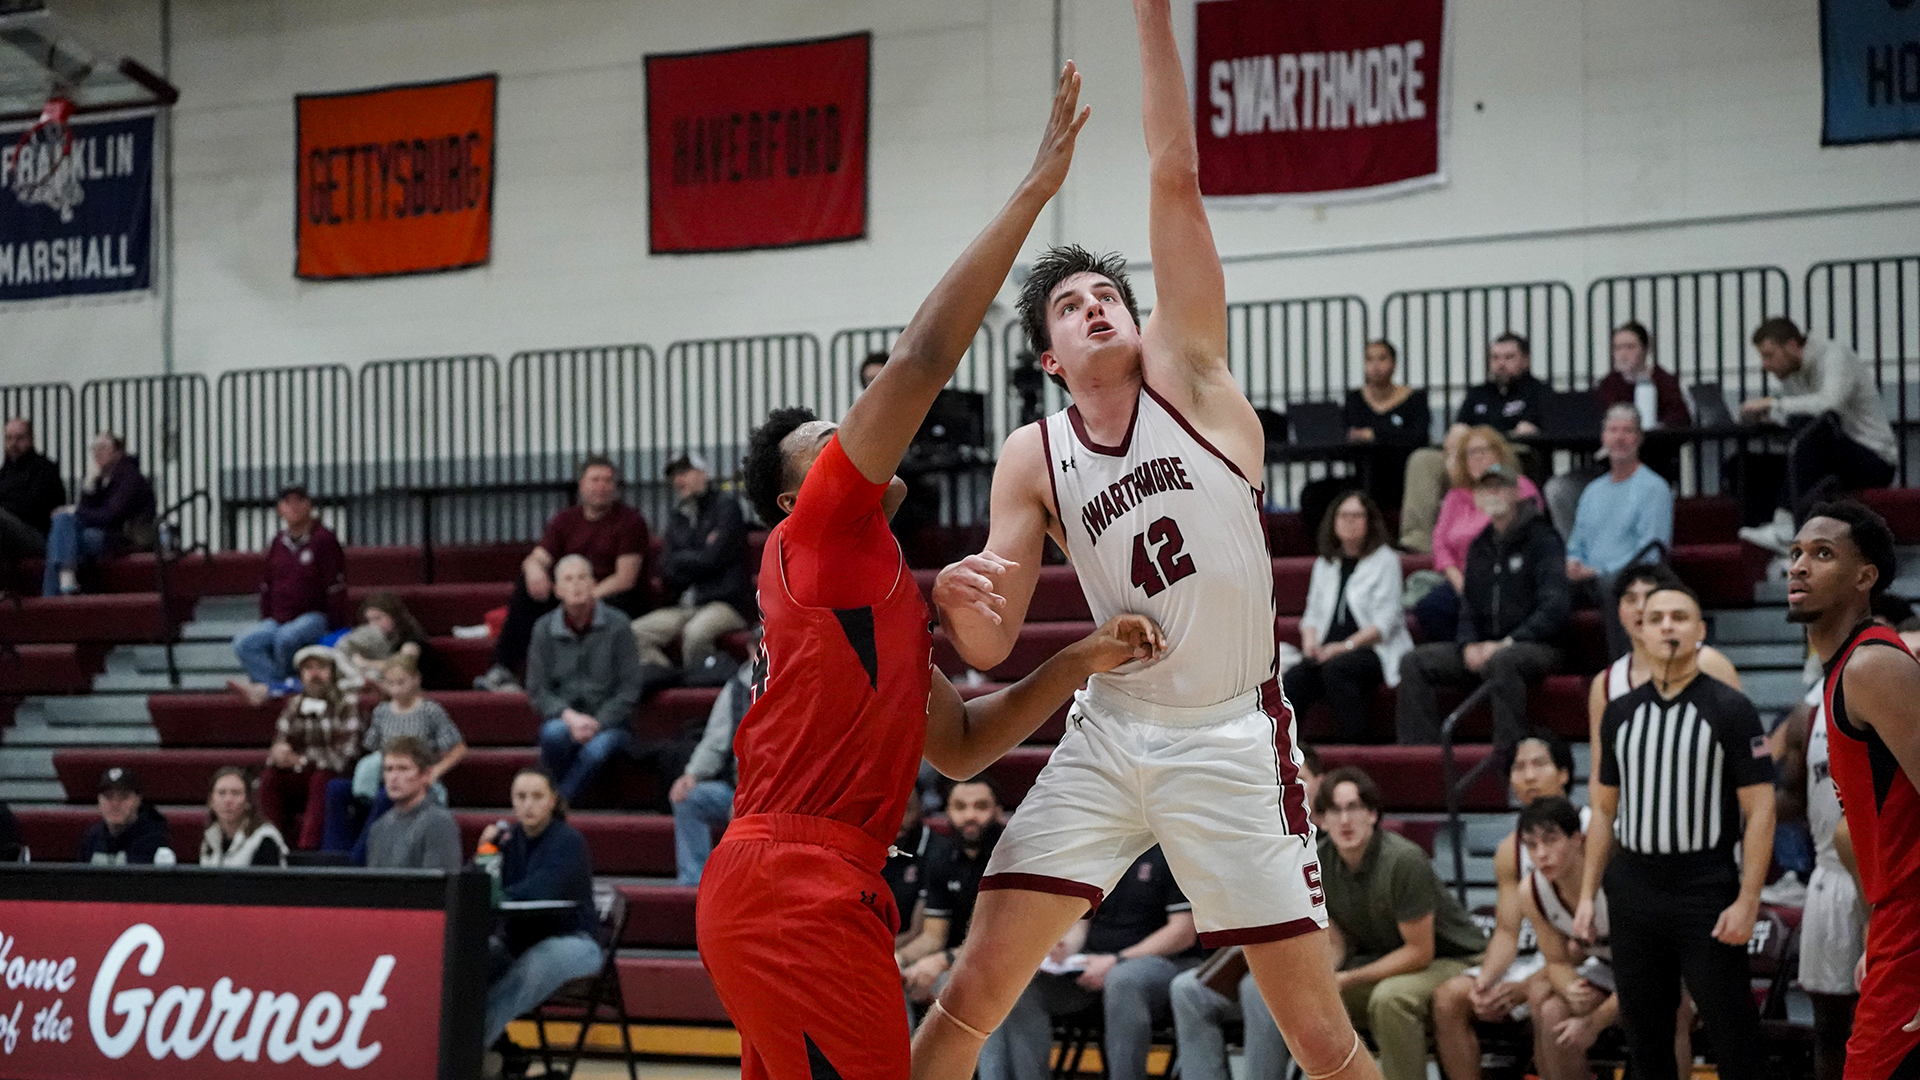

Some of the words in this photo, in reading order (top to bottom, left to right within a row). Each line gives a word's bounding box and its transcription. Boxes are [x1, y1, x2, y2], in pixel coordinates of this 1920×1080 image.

[1210, 39, 1424, 138] SWARTHMORE
[308, 131, 482, 226] GETTYSBURG
[673, 105, 840, 185] HAVERFORD
[0, 234, 136, 286] MARSHALL
[1131, 515, 1197, 599] 42
[1302, 861, 1326, 908] S
[32, 998, 74, 1043] the
[88, 923, 396, 1070] Garnet
